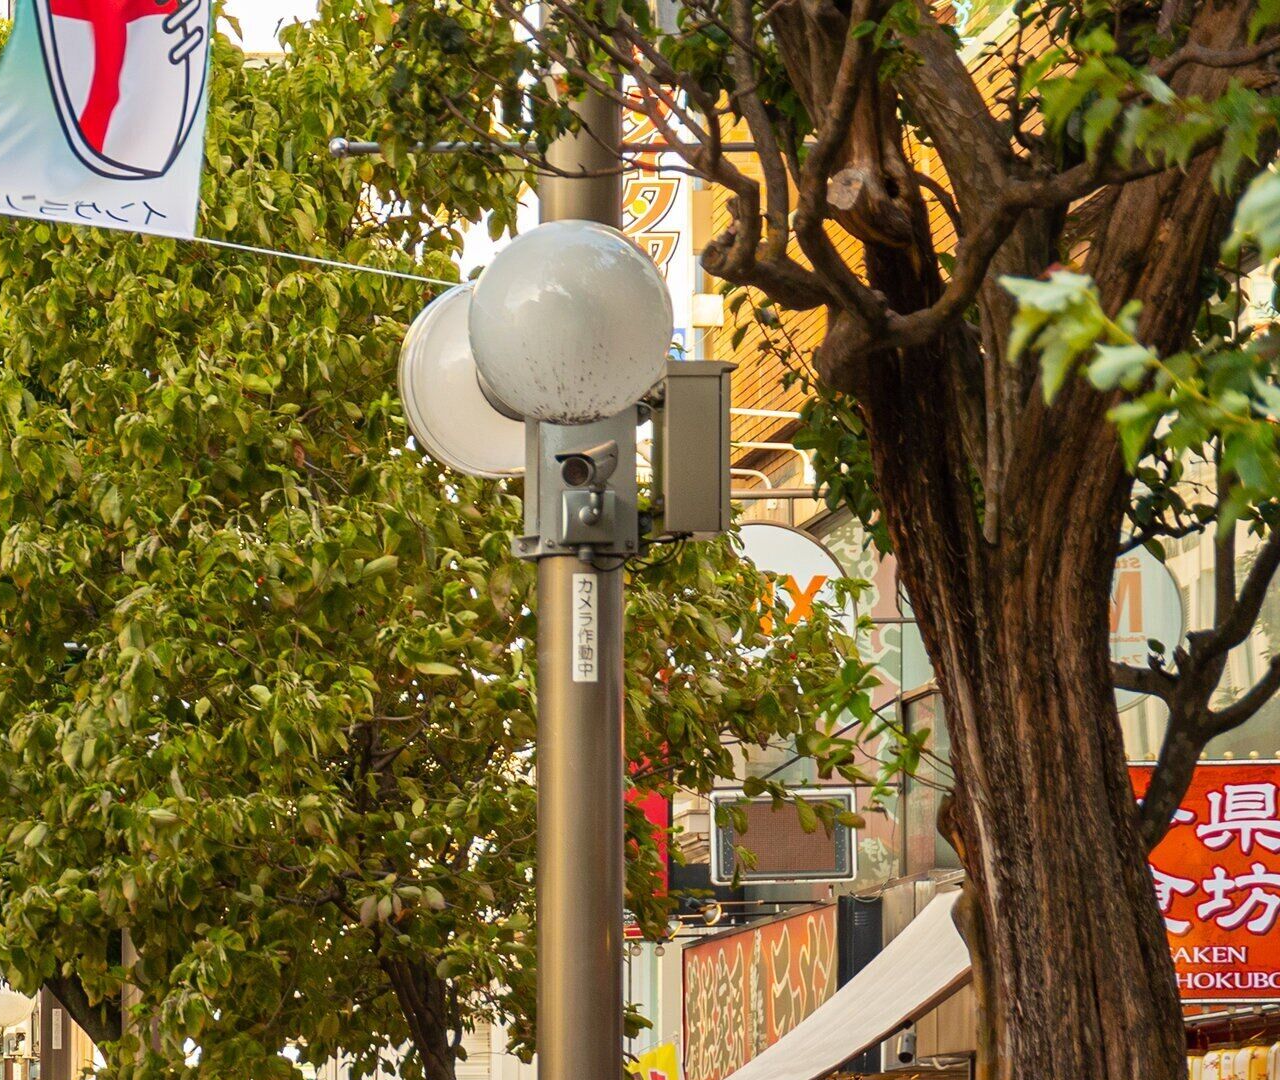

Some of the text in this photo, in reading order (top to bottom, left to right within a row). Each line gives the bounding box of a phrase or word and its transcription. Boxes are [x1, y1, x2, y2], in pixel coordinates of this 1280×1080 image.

[578, 578, 593, 677] カメラ作動中
[1169, 946, 1247, 963] AKEN
